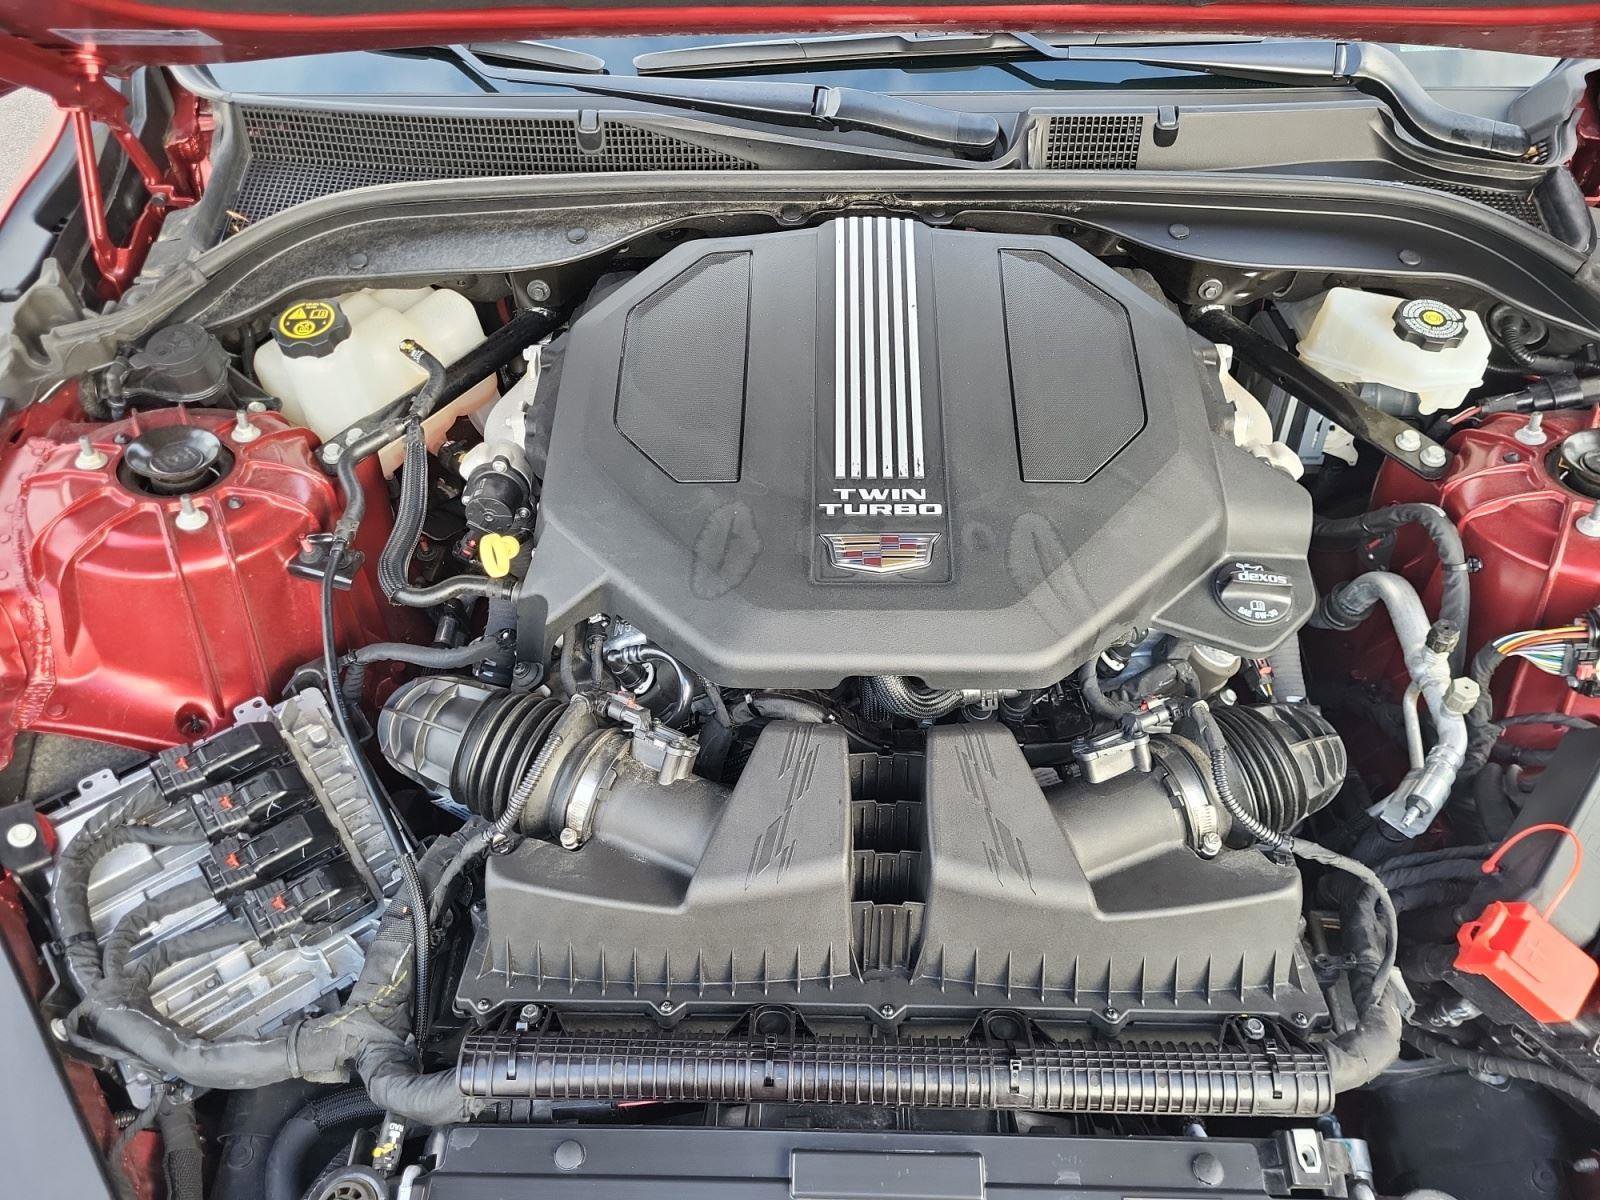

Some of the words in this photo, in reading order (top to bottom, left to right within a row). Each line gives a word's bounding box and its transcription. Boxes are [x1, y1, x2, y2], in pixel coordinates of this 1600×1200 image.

[833, 488, 926, 500] TWIN
[819, 503, 942, 515] TURBO
[1238, 571, 1287, 584] dexos
